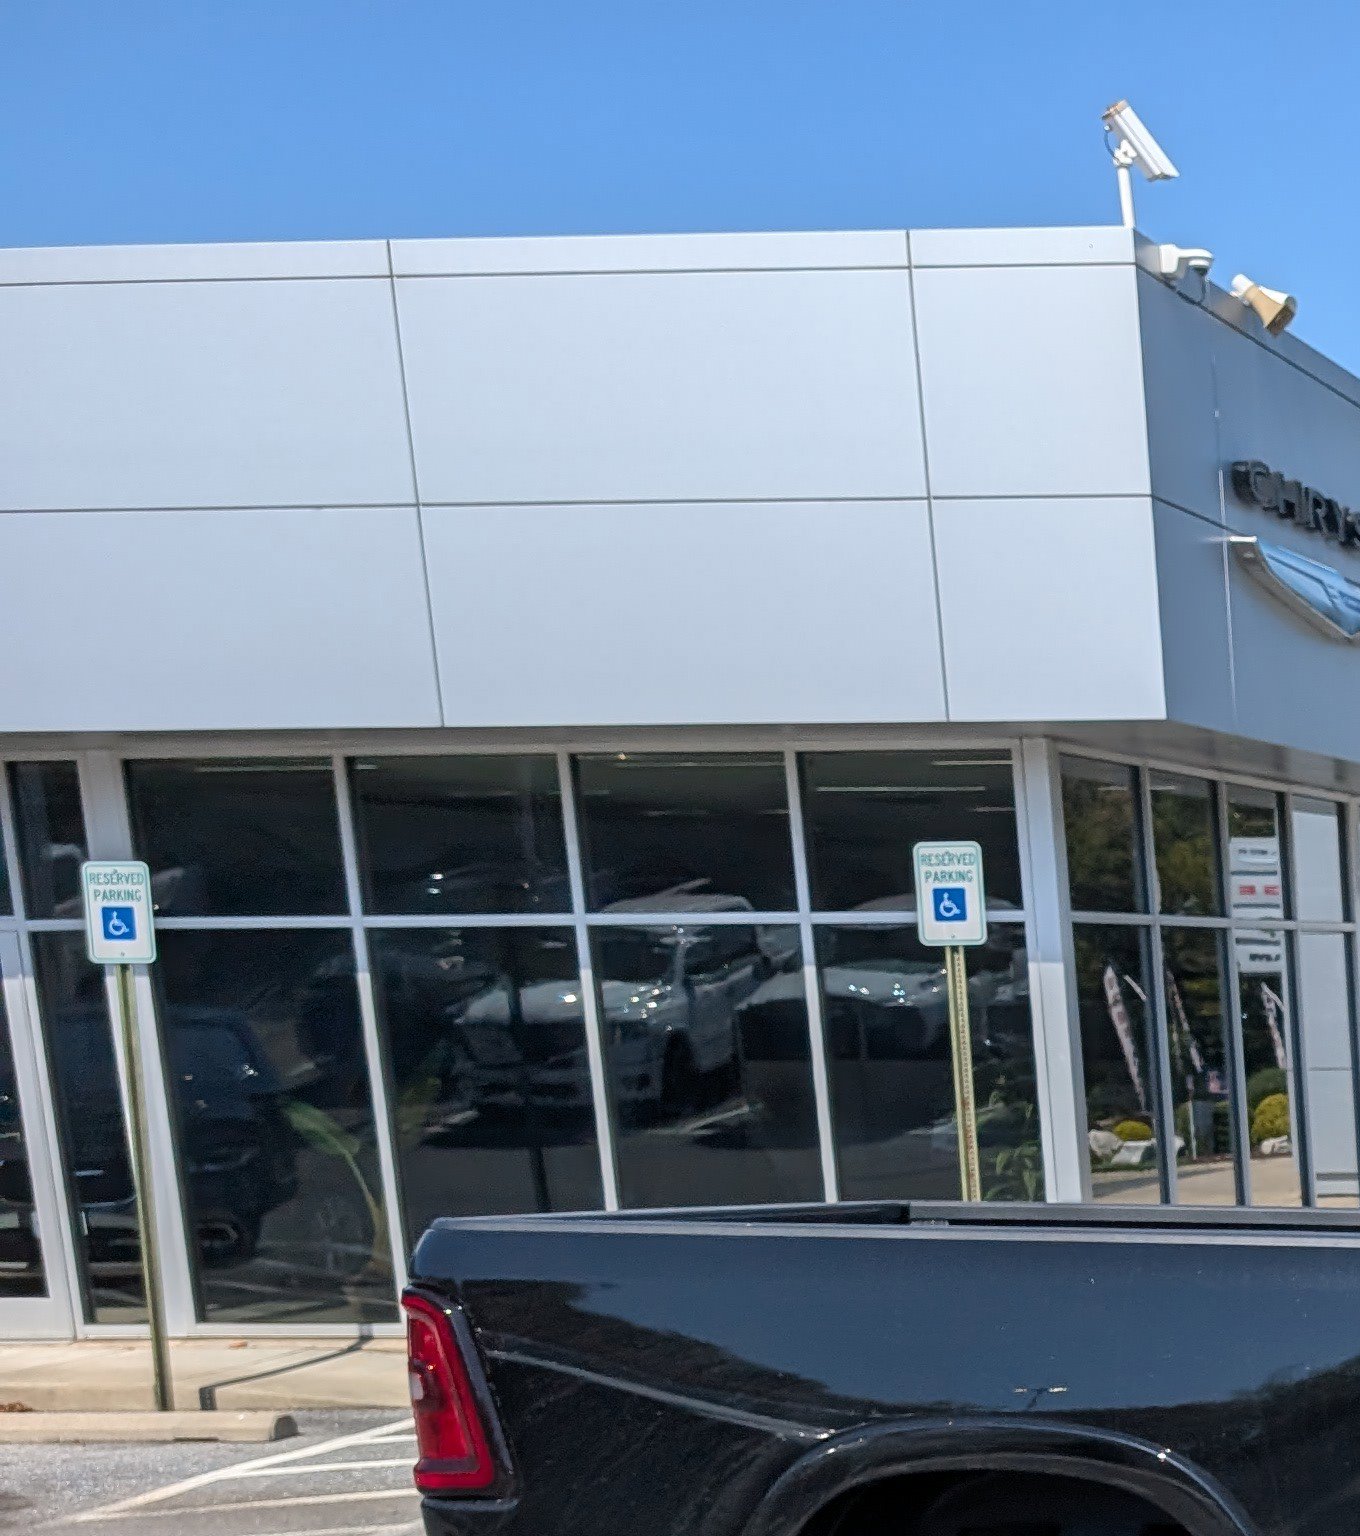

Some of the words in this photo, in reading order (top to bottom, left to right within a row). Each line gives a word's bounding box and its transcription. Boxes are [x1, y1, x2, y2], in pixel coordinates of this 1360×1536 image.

[920, 853, 976, 867] RESERVED
[89, 872, 145, 885] RESERVED
[925, 870, 973, 883] PARKING
[93, 889, 142, 902] PARKING
